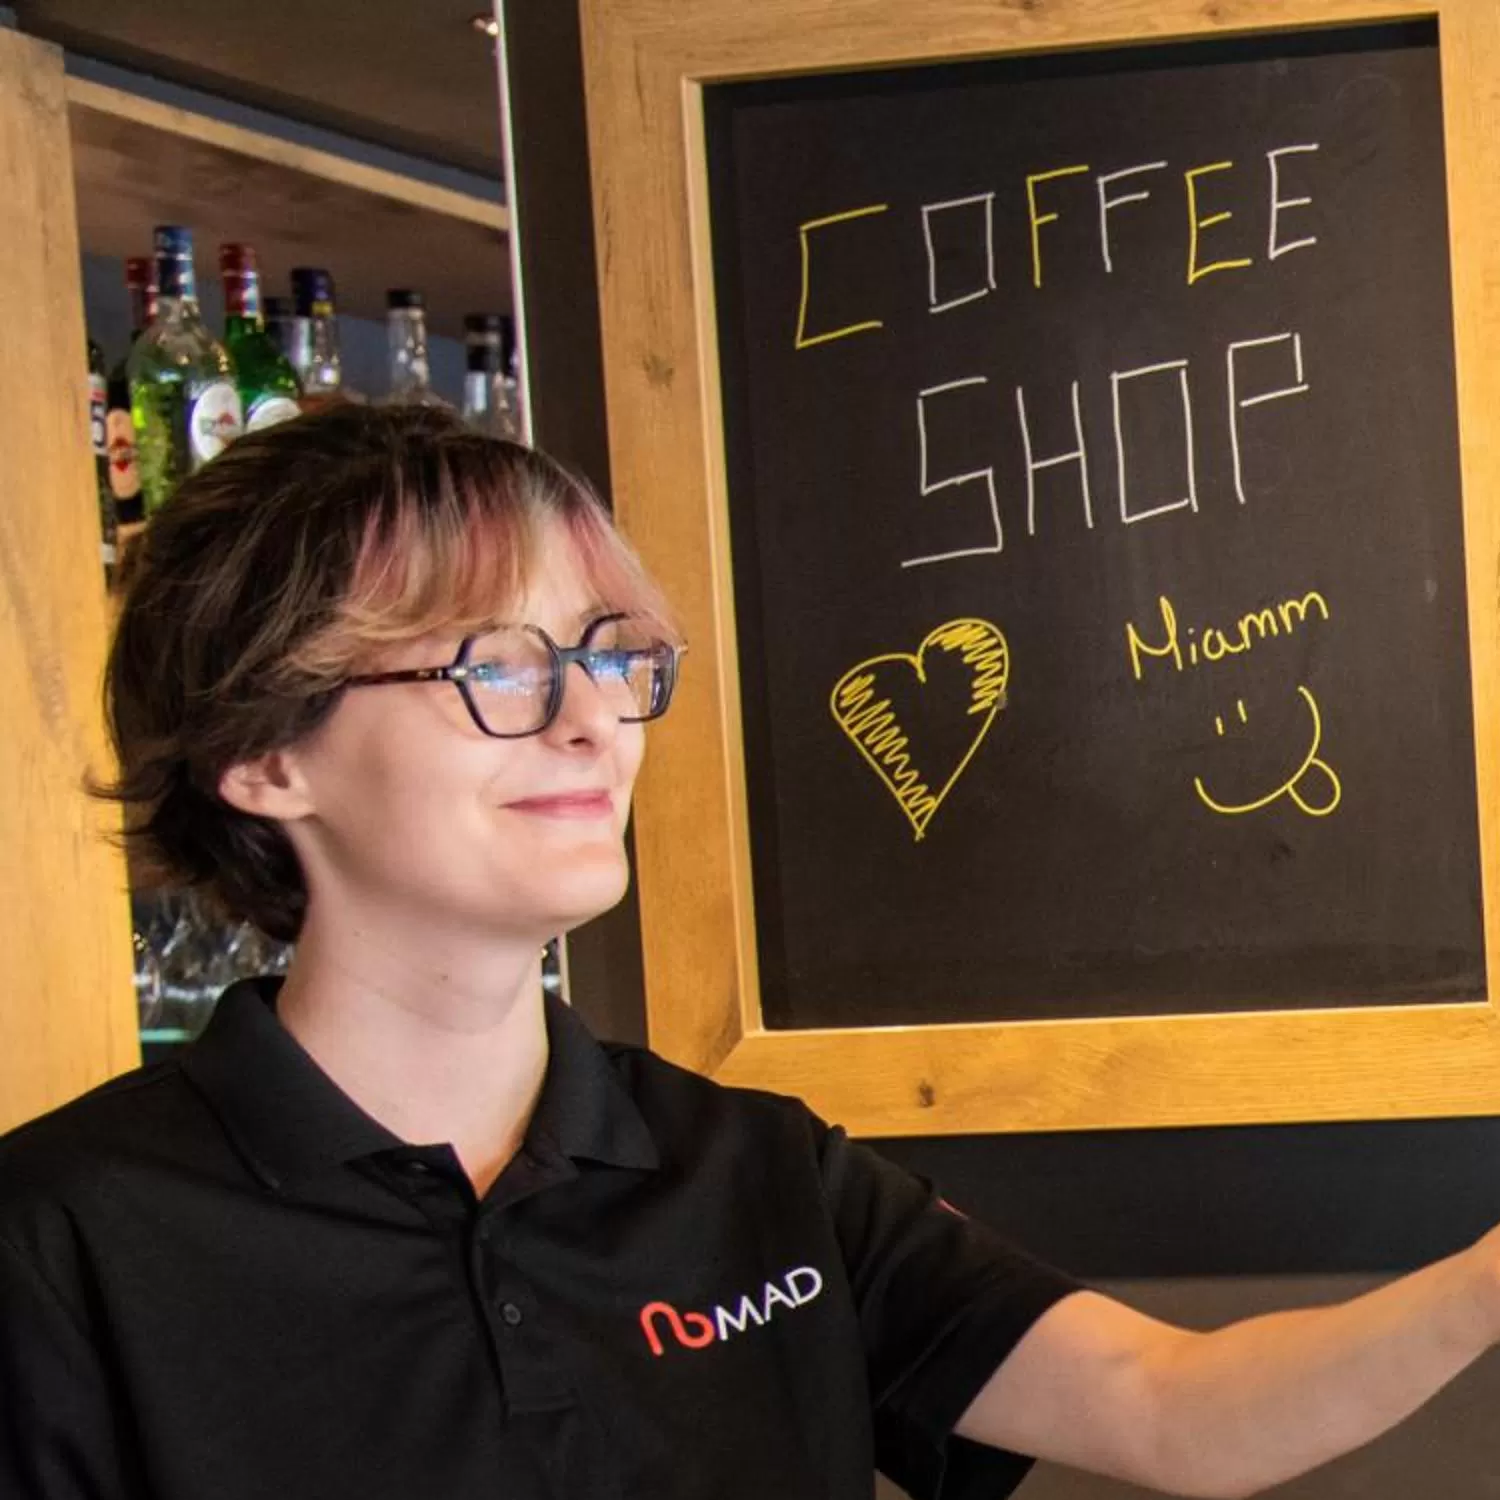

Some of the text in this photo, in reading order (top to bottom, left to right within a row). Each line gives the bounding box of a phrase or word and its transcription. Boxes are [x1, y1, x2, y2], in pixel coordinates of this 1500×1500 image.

[796, 143, 1320, 349] COFFEE
[899, 332, 1310, 568] SHOP
[1125, 592, 1329, 680] Miamm
